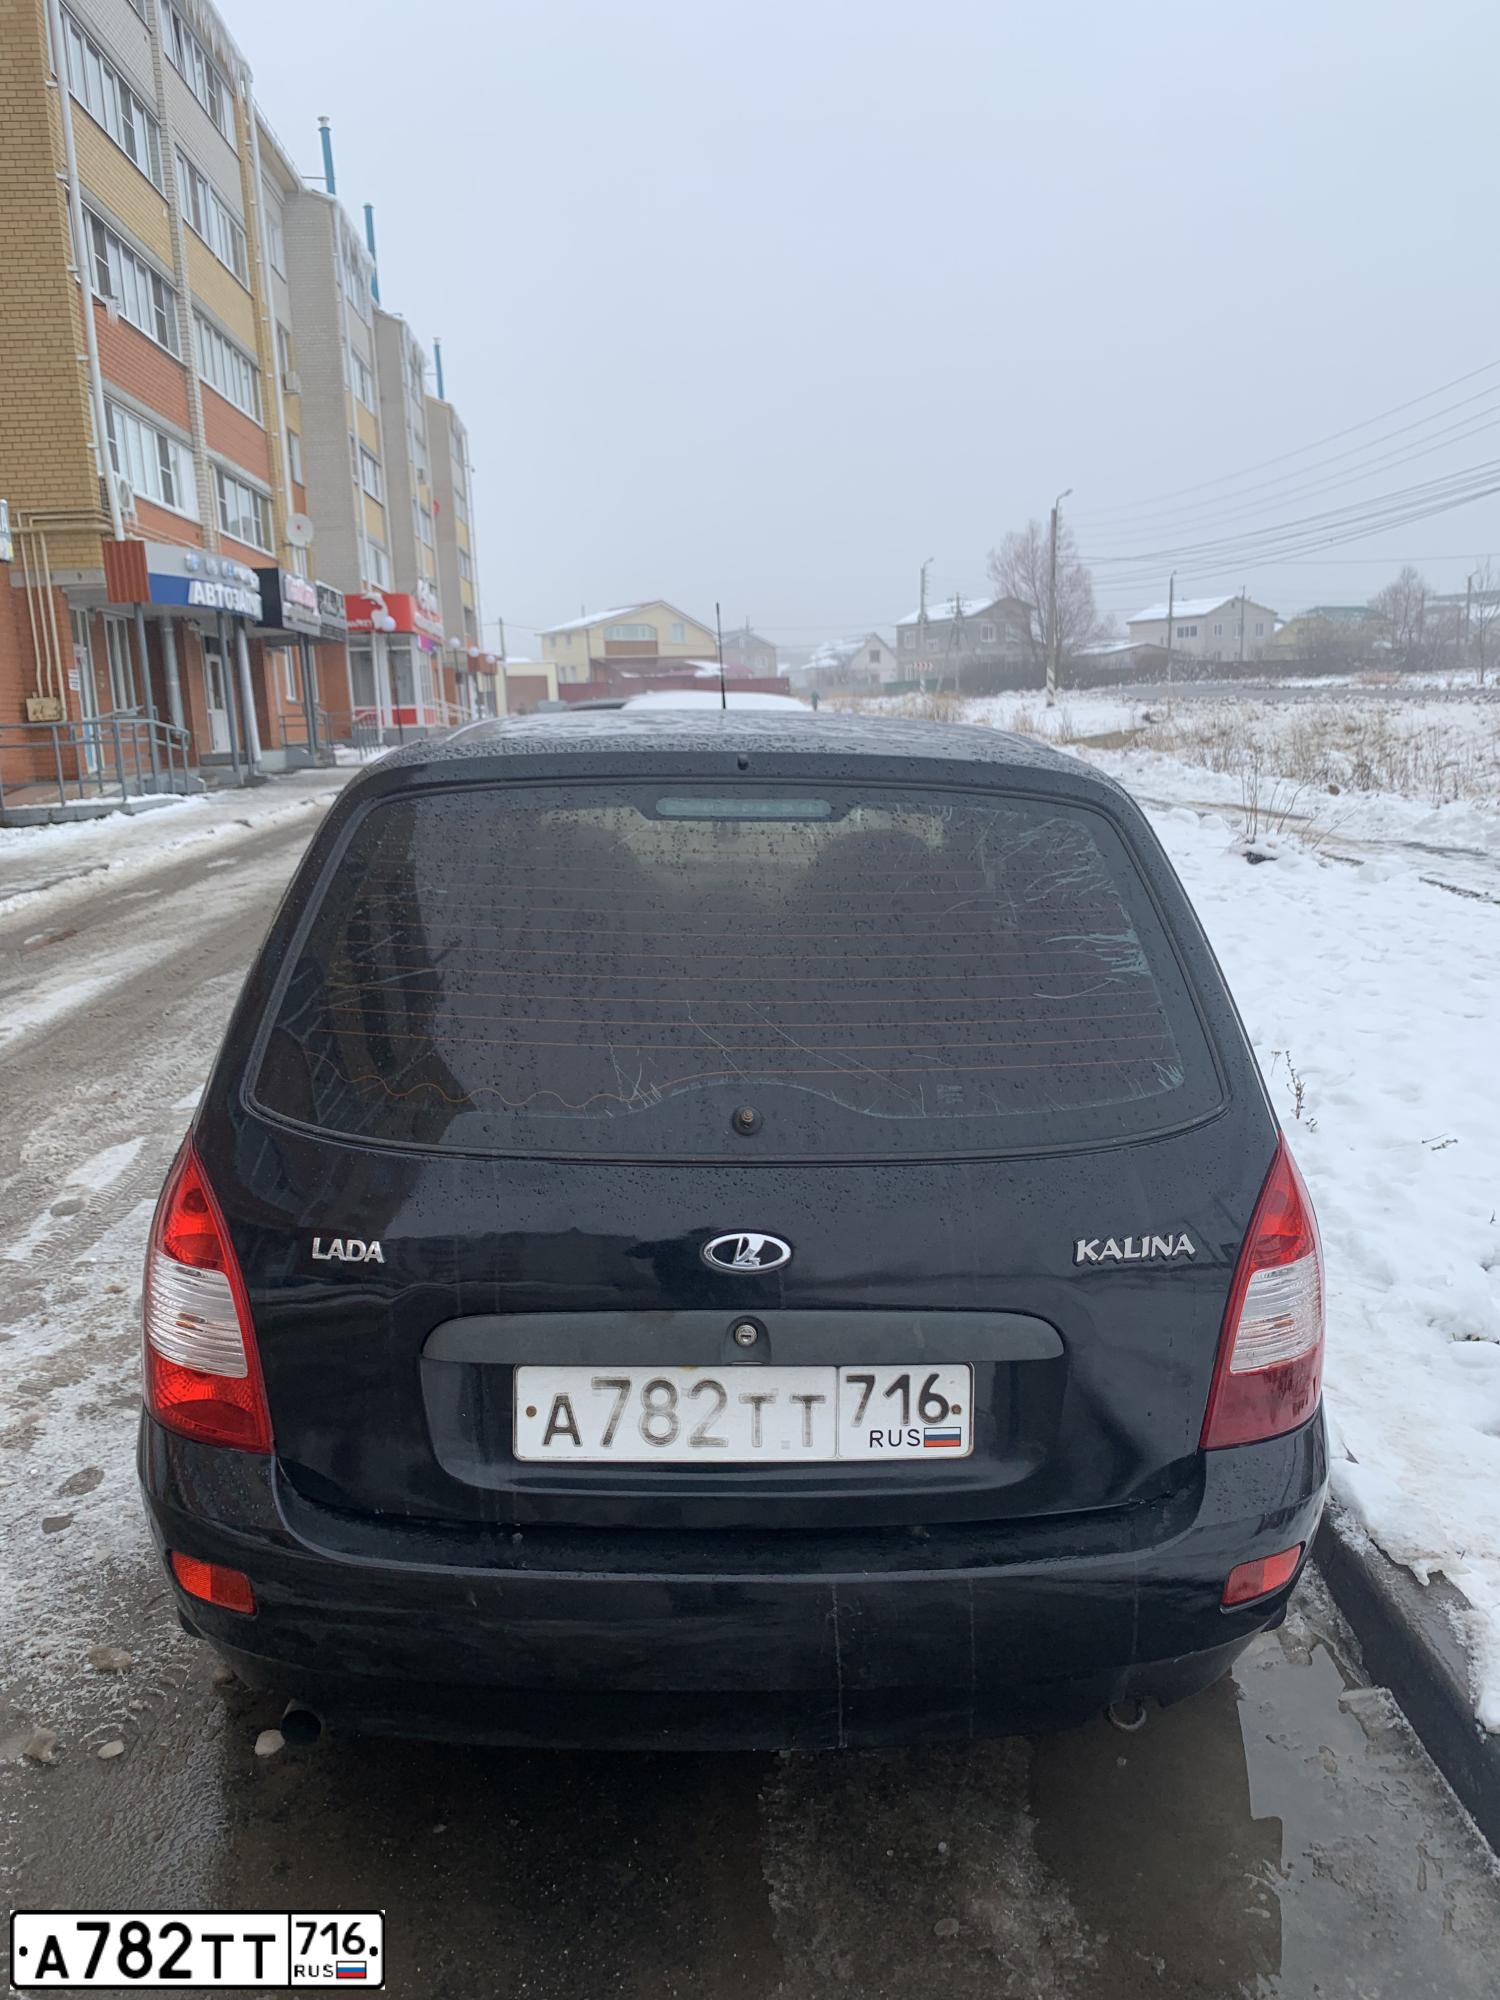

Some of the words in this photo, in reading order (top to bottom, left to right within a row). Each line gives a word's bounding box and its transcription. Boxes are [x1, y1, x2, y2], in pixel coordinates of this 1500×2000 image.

[311, 1237, 385, 1264] LADA
[1075, 1233, 1196, 1264] KALINA
[845, 1373, 950, 1427] 716
[869, 1427, 921, 1449] RUS
